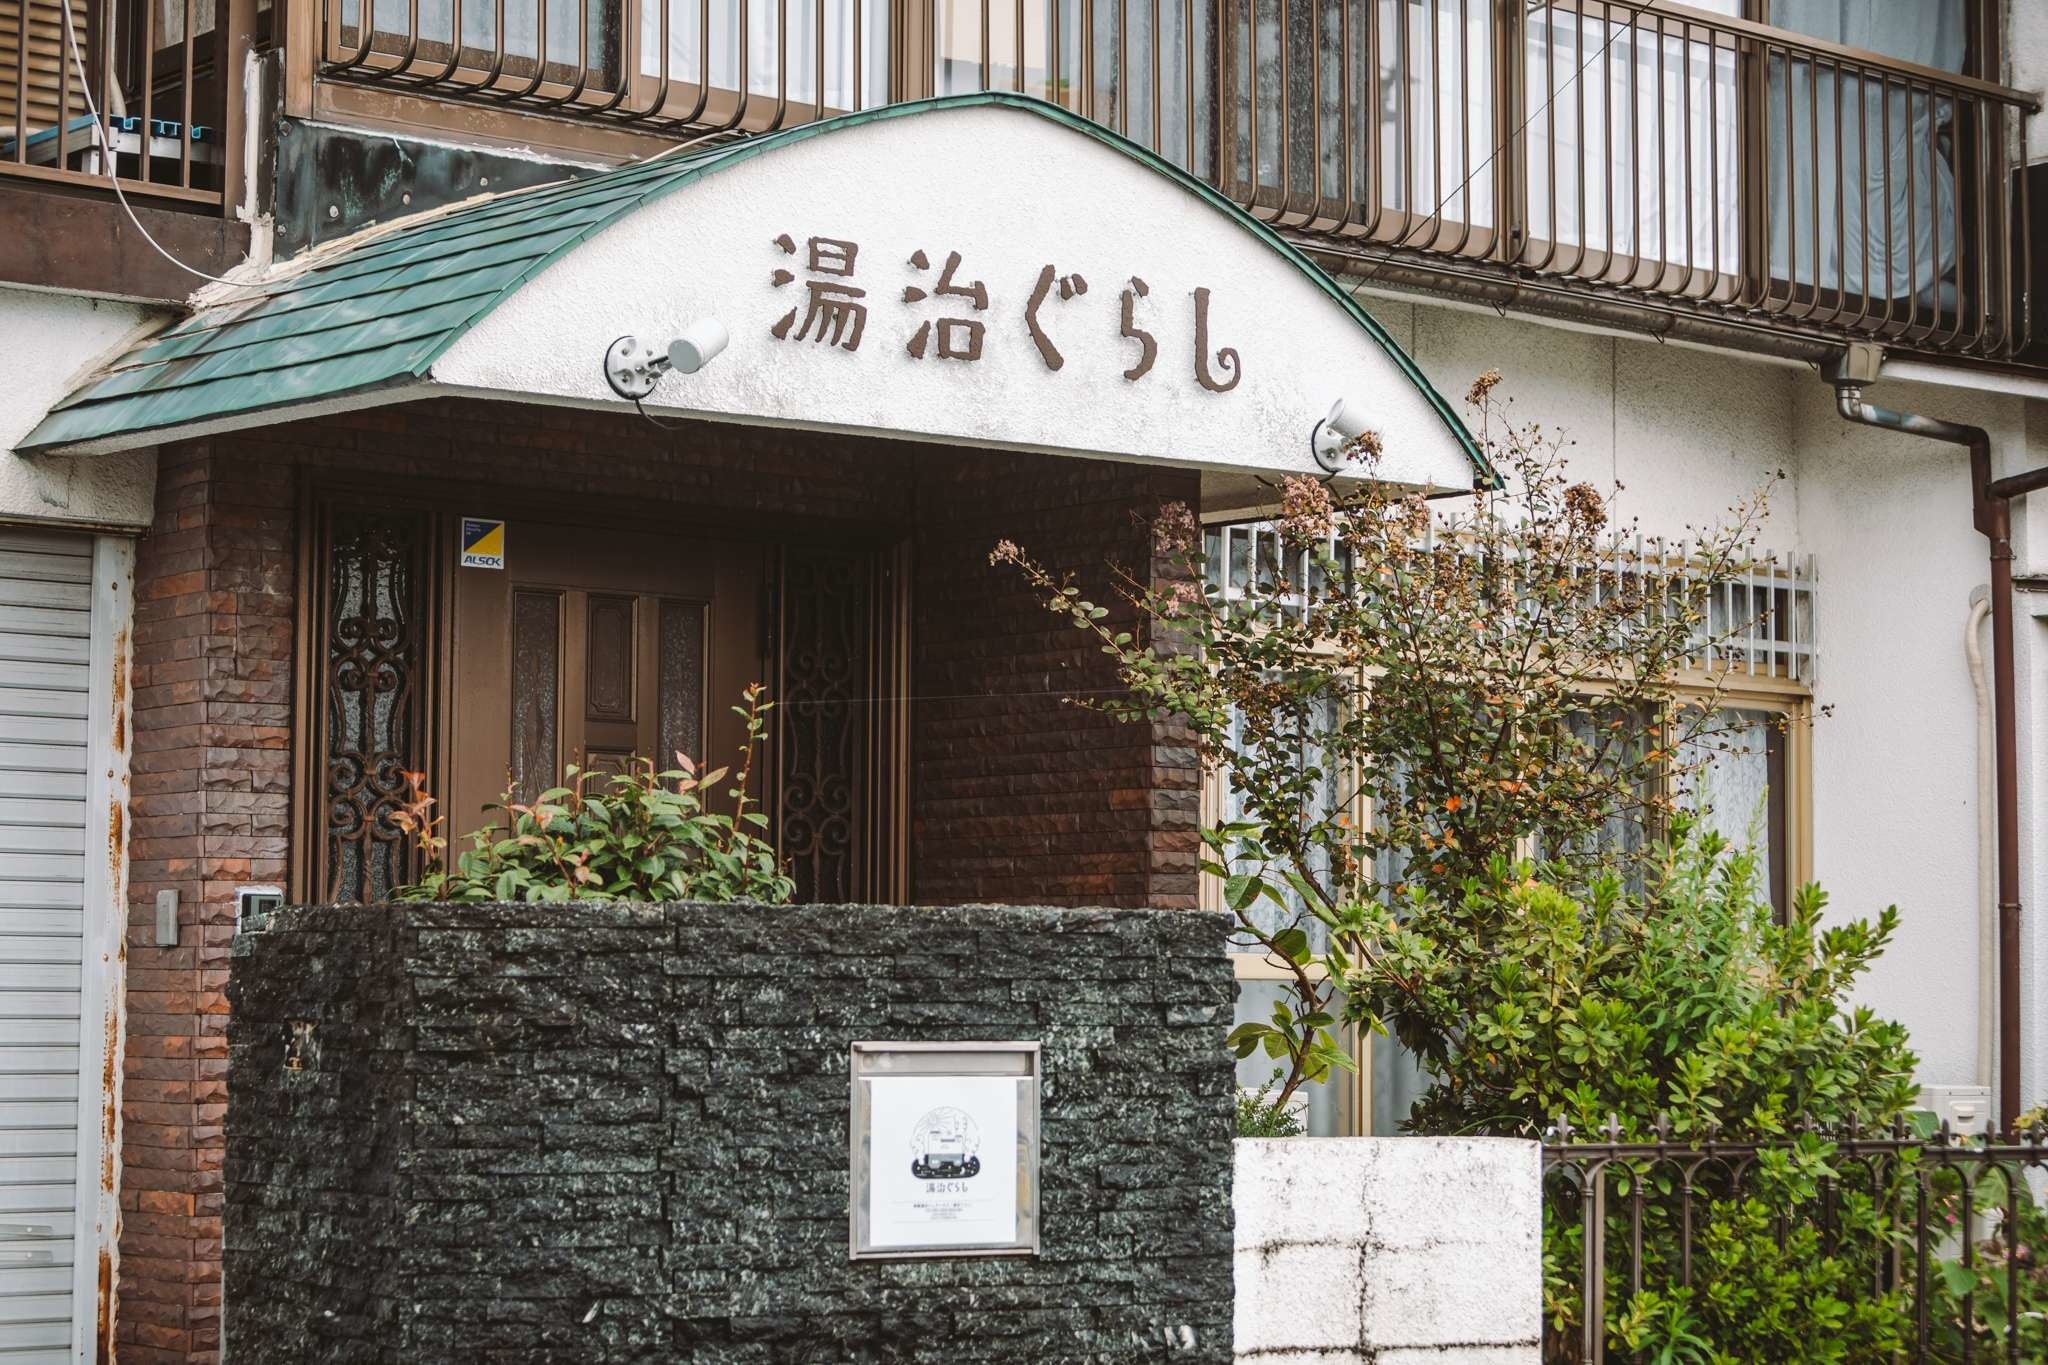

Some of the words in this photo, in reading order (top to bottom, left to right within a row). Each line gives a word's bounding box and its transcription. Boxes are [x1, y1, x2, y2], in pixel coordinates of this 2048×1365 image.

[772, 234, 1242, 393] 湯治ぐらし
[464, 555, 501, 566] ALSOK
